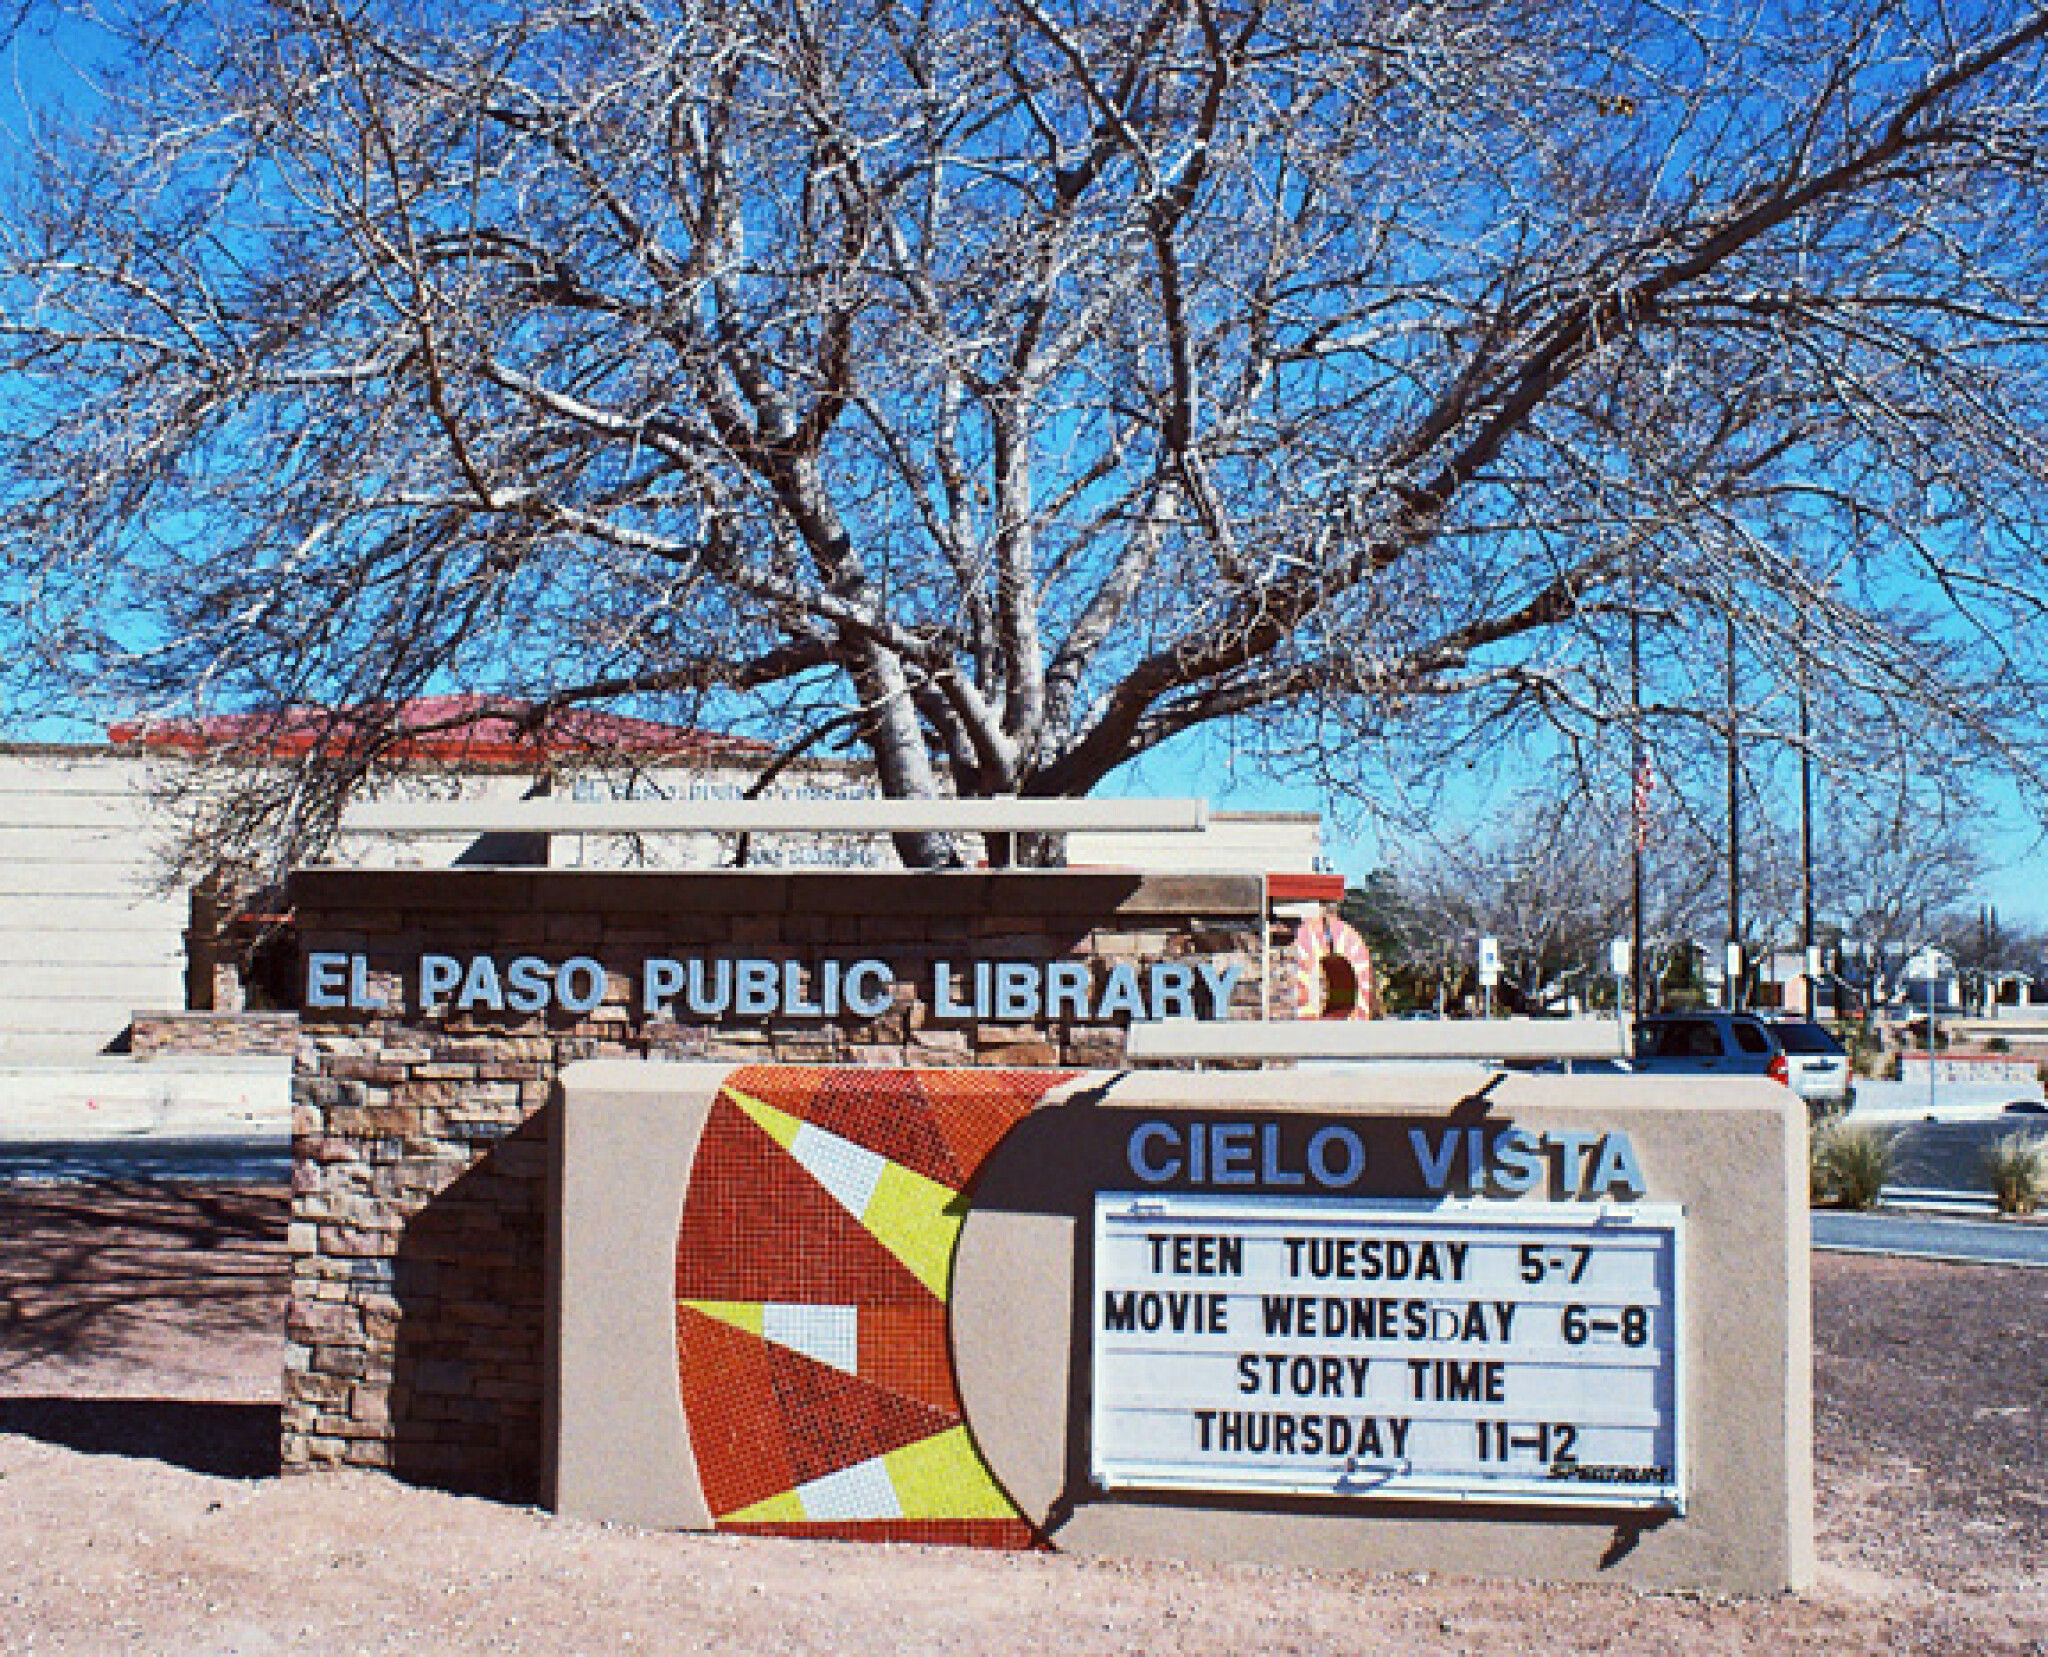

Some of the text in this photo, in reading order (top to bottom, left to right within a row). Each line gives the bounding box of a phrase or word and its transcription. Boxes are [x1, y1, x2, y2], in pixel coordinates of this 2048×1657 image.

[308, 952, 1246, 1020] EL PASO PUBLIC LIBRARY
[1127, 1119, 1647, 1194] CIELO VISTA
[1147, 1233, 1594, 1285] TEEN TUESDAY 5-7
[1104, 1290, 1649, 1346] MOVIE WEDNESDAY 6-8
[1237, 1354, 1506, 1402] STORY TIME
[1194, 1410, 1579, 1464] THURSDAY 11-12
